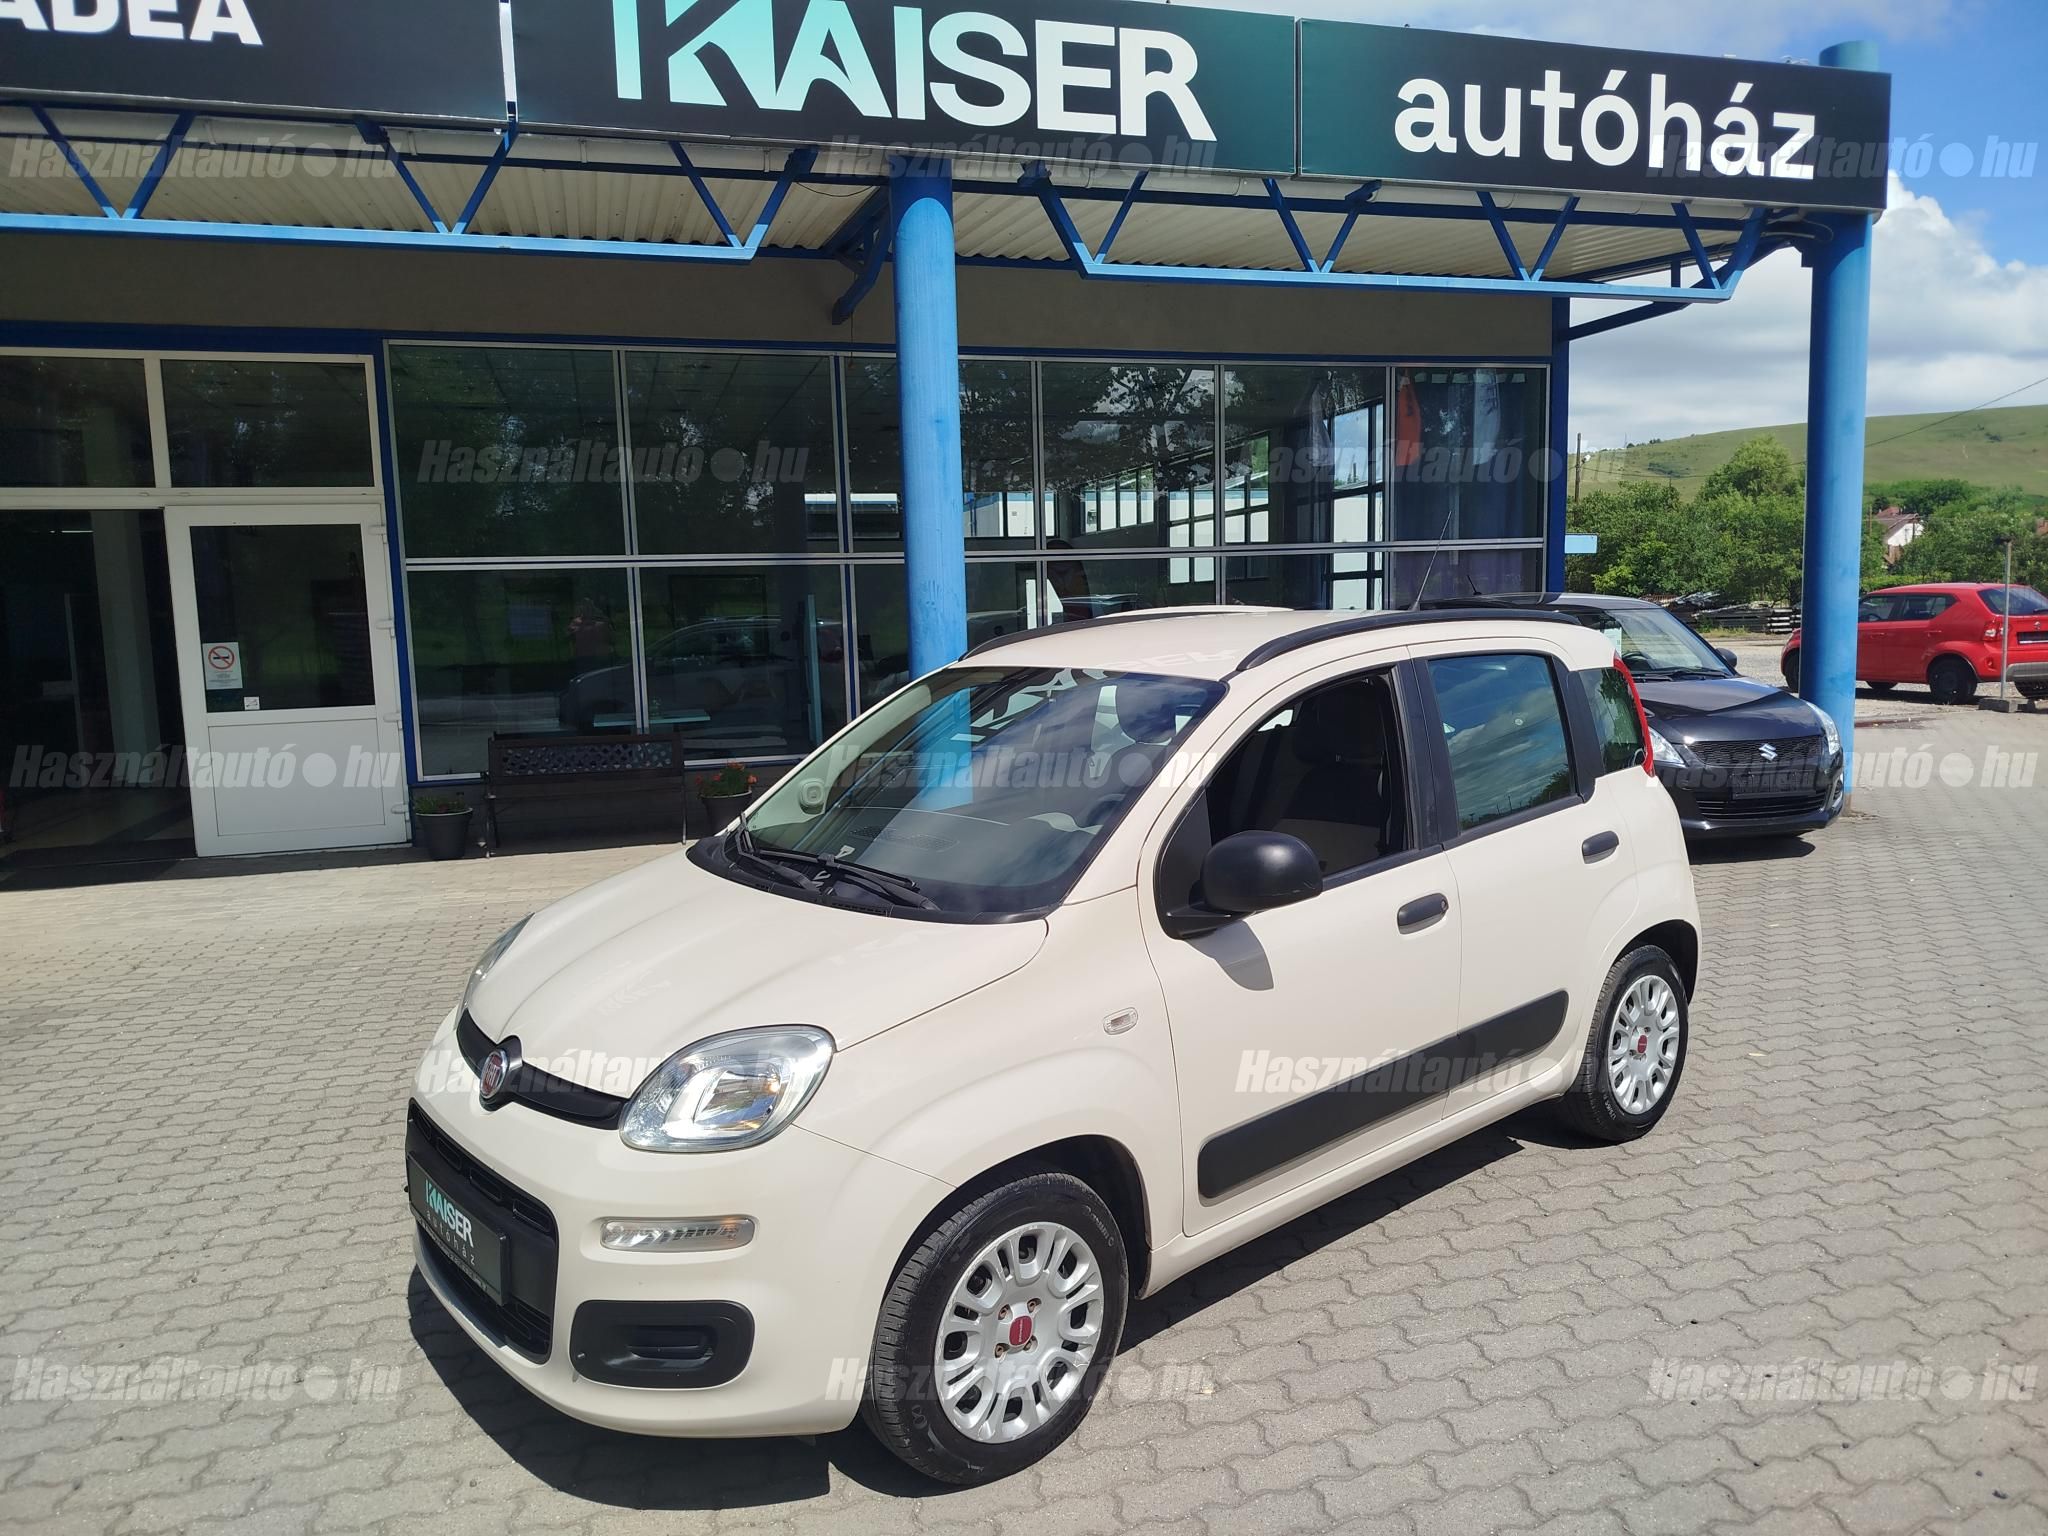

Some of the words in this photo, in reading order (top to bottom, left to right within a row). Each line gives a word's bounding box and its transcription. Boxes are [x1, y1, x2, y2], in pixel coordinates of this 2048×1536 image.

[612, 0, 1217, 142] KAISER
[1394, 68, 1817, 181] autóház
[425, 1179, 475, 1248] KAISER
